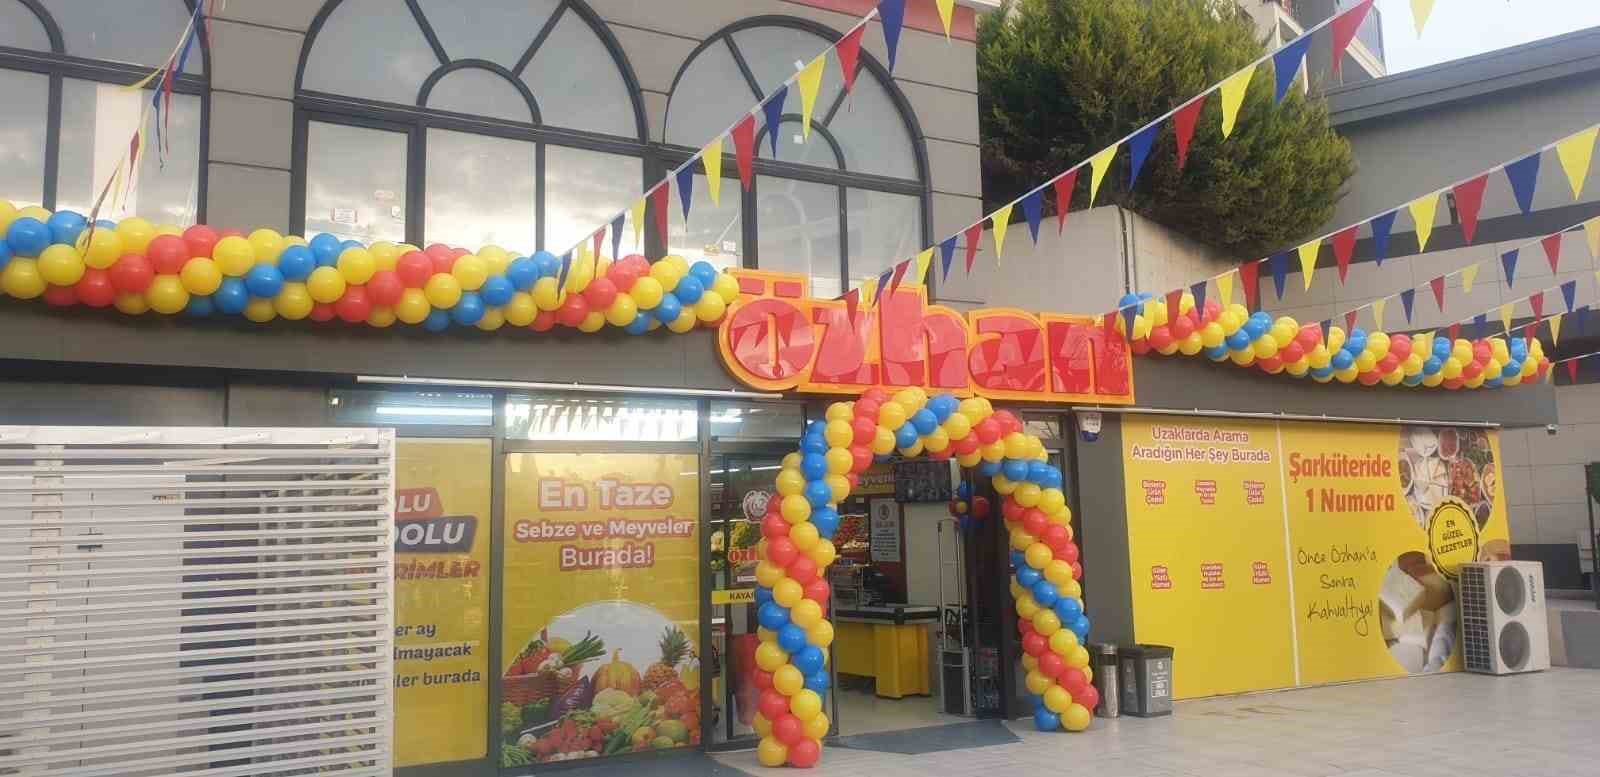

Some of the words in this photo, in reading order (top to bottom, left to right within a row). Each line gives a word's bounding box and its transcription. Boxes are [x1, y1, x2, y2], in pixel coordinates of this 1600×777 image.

[1151, 427, 1209, 441] Uzaklarda
[1213, 430, 1249, 443] Arama
[1132, 446, 1182, 461] Aradığın
[1185, 448, 1206, 460] Her
[1209, 449, 1229, 463] Şey
[1232, 450, 1270, 462] Burada
[1289, 452, 1391, 483] Şarküteride
[541, 480, 584, 507] En
[595, 480, 672, 507] Taze
[1305, 488, 1314, 513] 1
[1321, 488, 1395, 513] Numara
[394, 522, 465, 545] OLU
[516, 522, 576, 539] Sebze
[582, 523, 605, 535] ve
[608, 518, 691, 537] Meyveler
[562, 545, 652, 566] Burada!
[416, 624, 436, 638] ay
[423, 669, 480, 686] burada
